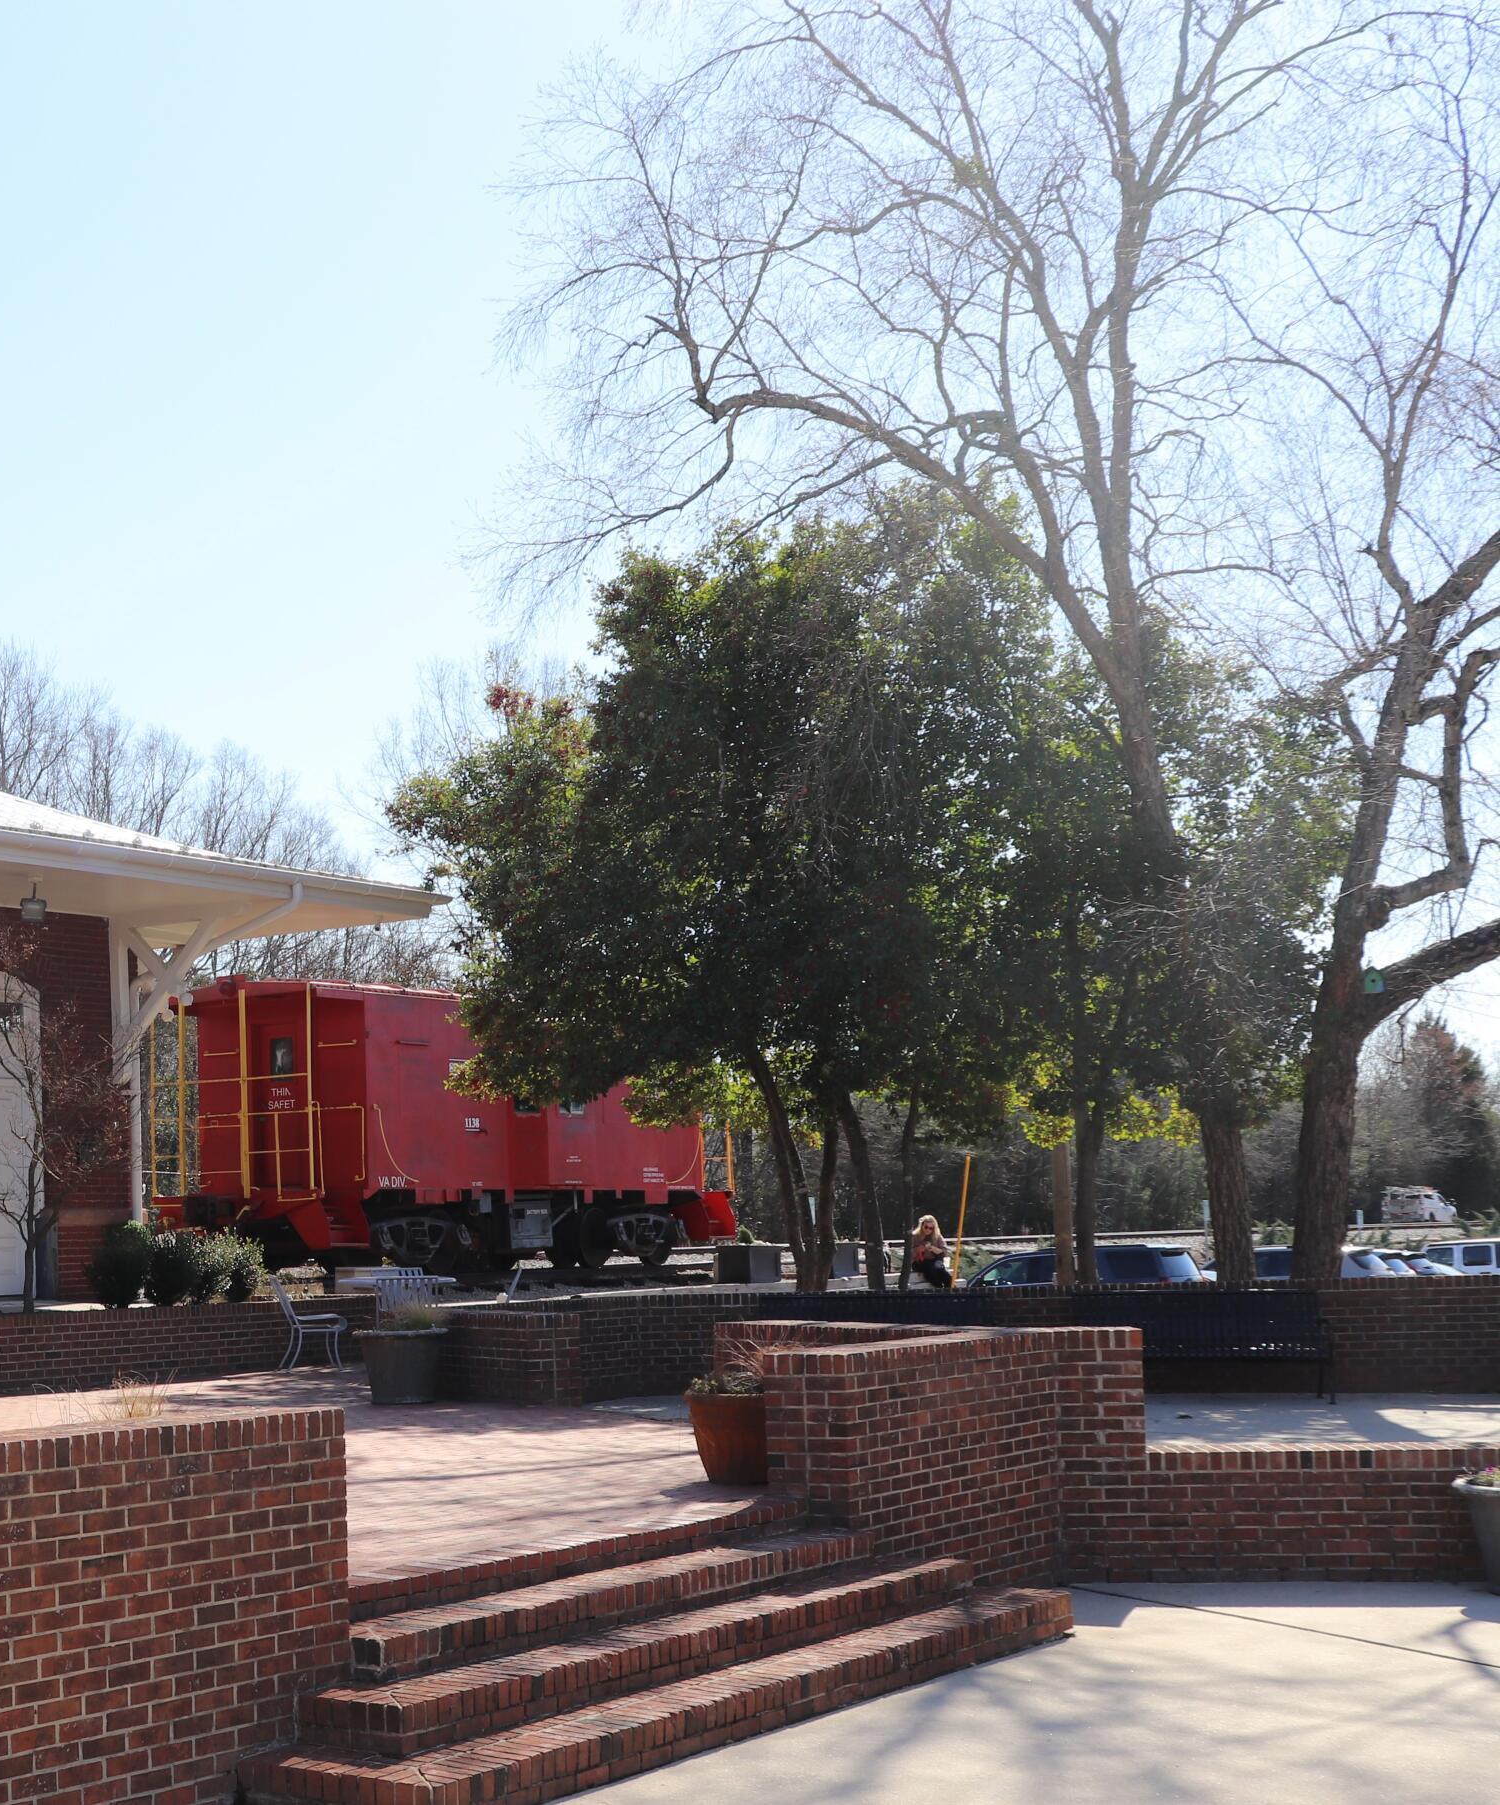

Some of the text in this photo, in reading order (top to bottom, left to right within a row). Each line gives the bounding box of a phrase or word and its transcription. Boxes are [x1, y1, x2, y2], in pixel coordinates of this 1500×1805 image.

[464, 1117, 480, 1129] 1138
[378, 1176, 408, 1188] VA DIV.
